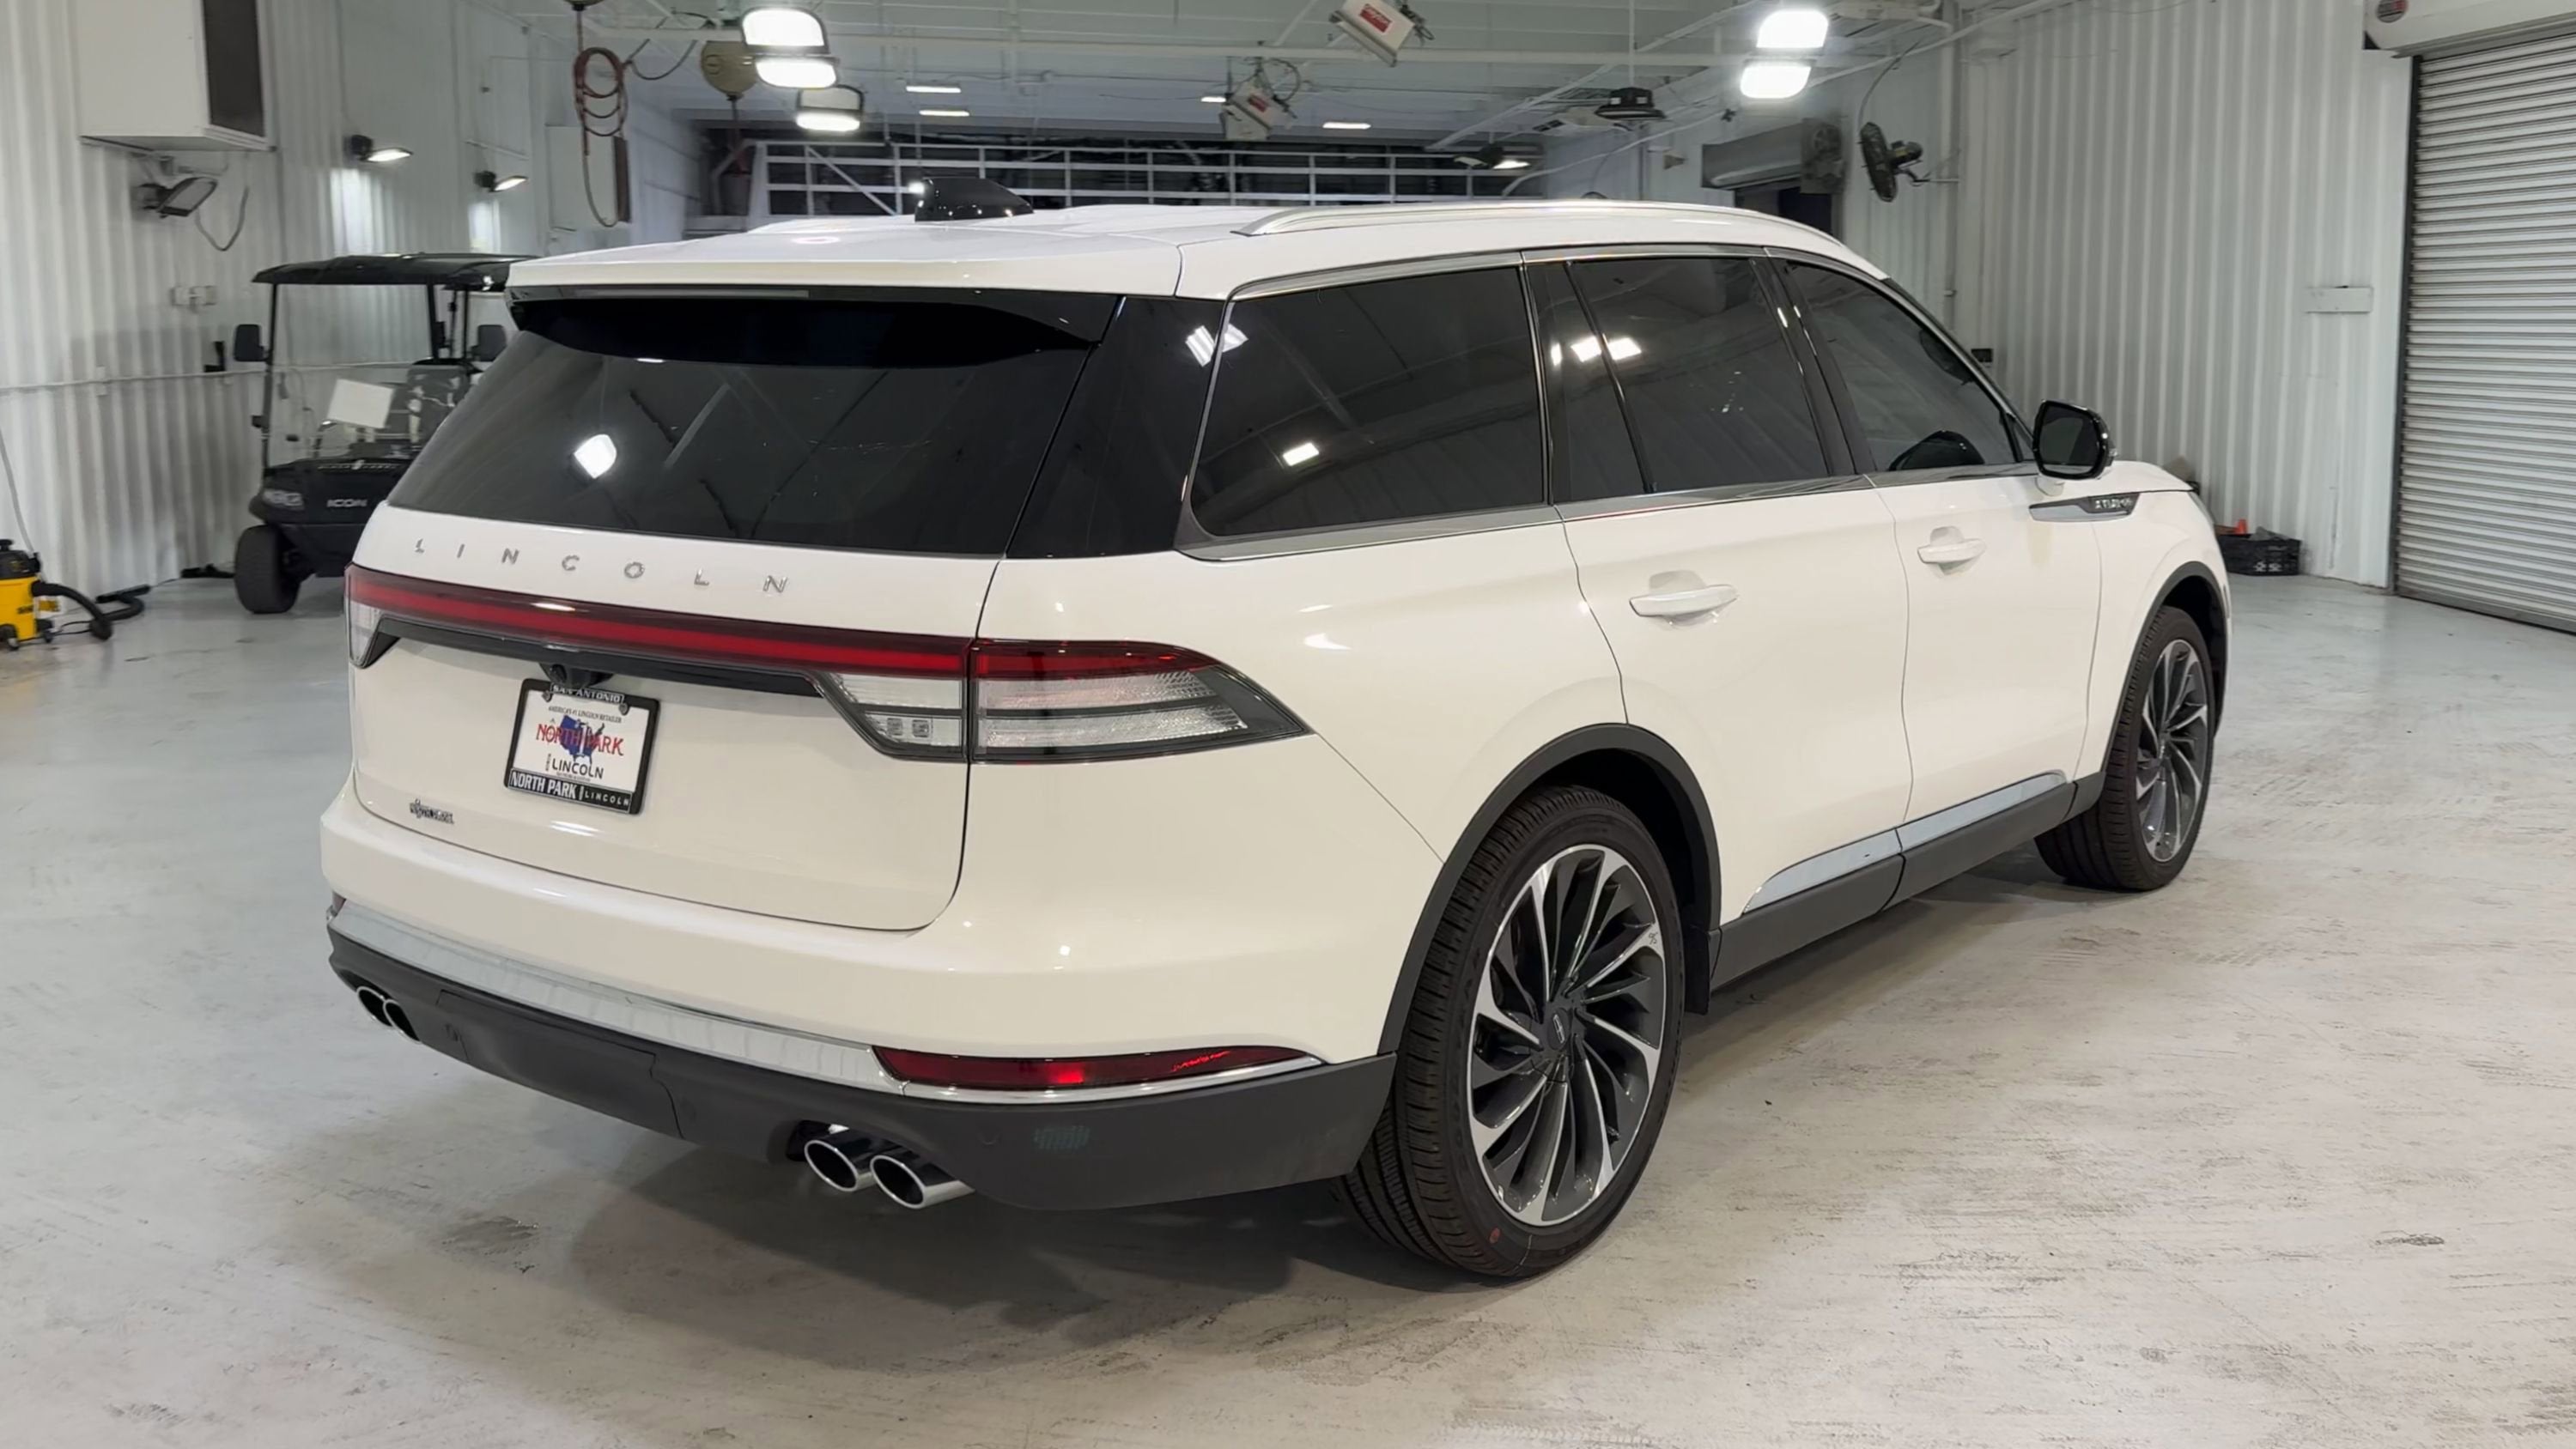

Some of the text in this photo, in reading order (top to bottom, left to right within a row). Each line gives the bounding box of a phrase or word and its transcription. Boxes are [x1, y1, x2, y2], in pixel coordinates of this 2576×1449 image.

[327, 499, 368, 507] ICON
[415, 538, 787, 593] LINCOLN
[576, 688, 620, 702] ANTONIO
[536, 724, 624, 756] NORTH PARK
[552, 758, 604, 779] LINCOLN
[511, 770, 544, 792] NORTH
[547, 780, 576, 799] PARK
[585, 790, 629, 807] LINCOLN
